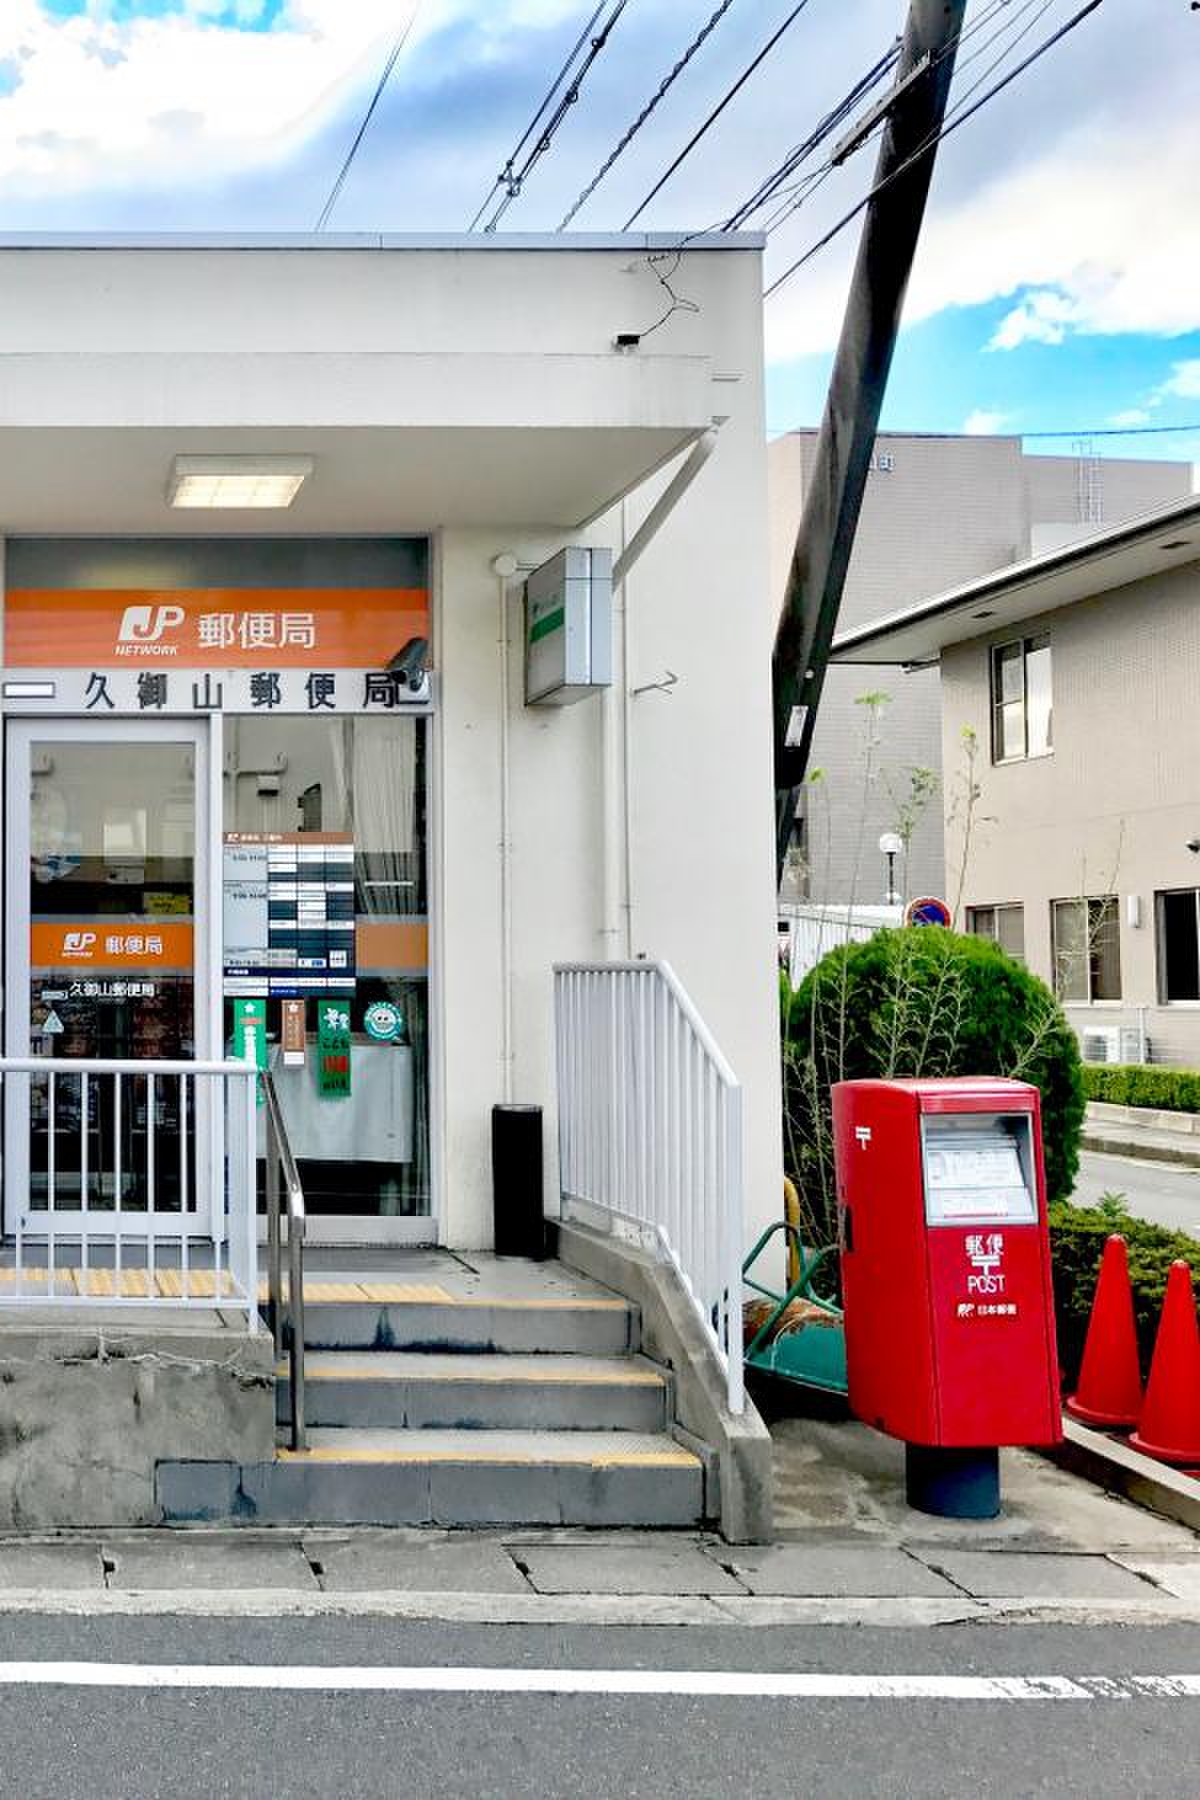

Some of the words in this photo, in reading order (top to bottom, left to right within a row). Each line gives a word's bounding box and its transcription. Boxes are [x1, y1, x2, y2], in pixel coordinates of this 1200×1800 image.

[118, 606, 185, 641] JP
[198, 612, 315, 649] 郵便局
[114, 644, 177, 657] NETWORK
[85, 671, 399, 710] 久御山郵便局
[105, 935, 163, 955] 郵便局
[965, 1233, 1004, 1256] 郵便
[967, 1274, 1005, 1294] POST
